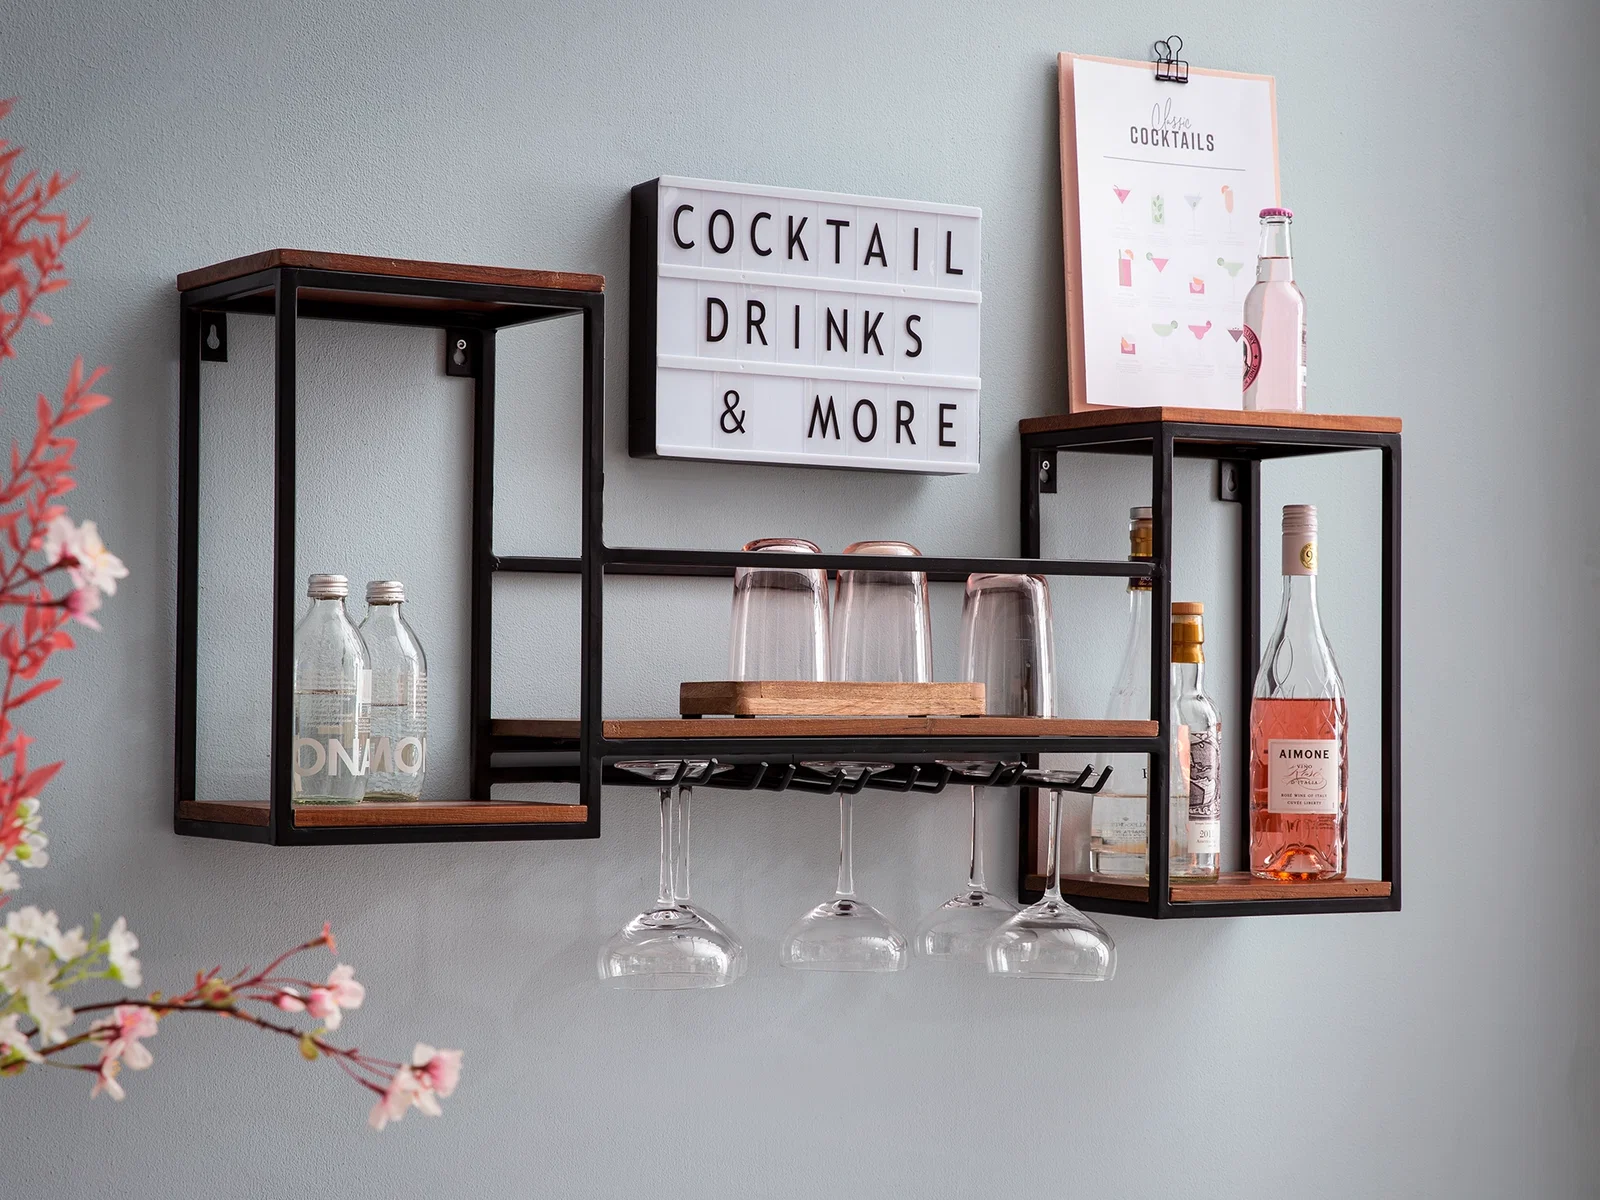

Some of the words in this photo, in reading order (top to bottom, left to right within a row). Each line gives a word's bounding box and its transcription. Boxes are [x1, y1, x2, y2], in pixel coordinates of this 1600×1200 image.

[1151, 97, 1192, 131] Classic
[1130, 126, 1214, 152] COCKTAILS
[673, 204, 964, 276] COCKTAIL
[706, 297, 923, 358] DRINKS
[720, 389, 746, 435] &
[807, 394, 957, 448] MORE
[1279, 749, 1329, 759] AIMONE
